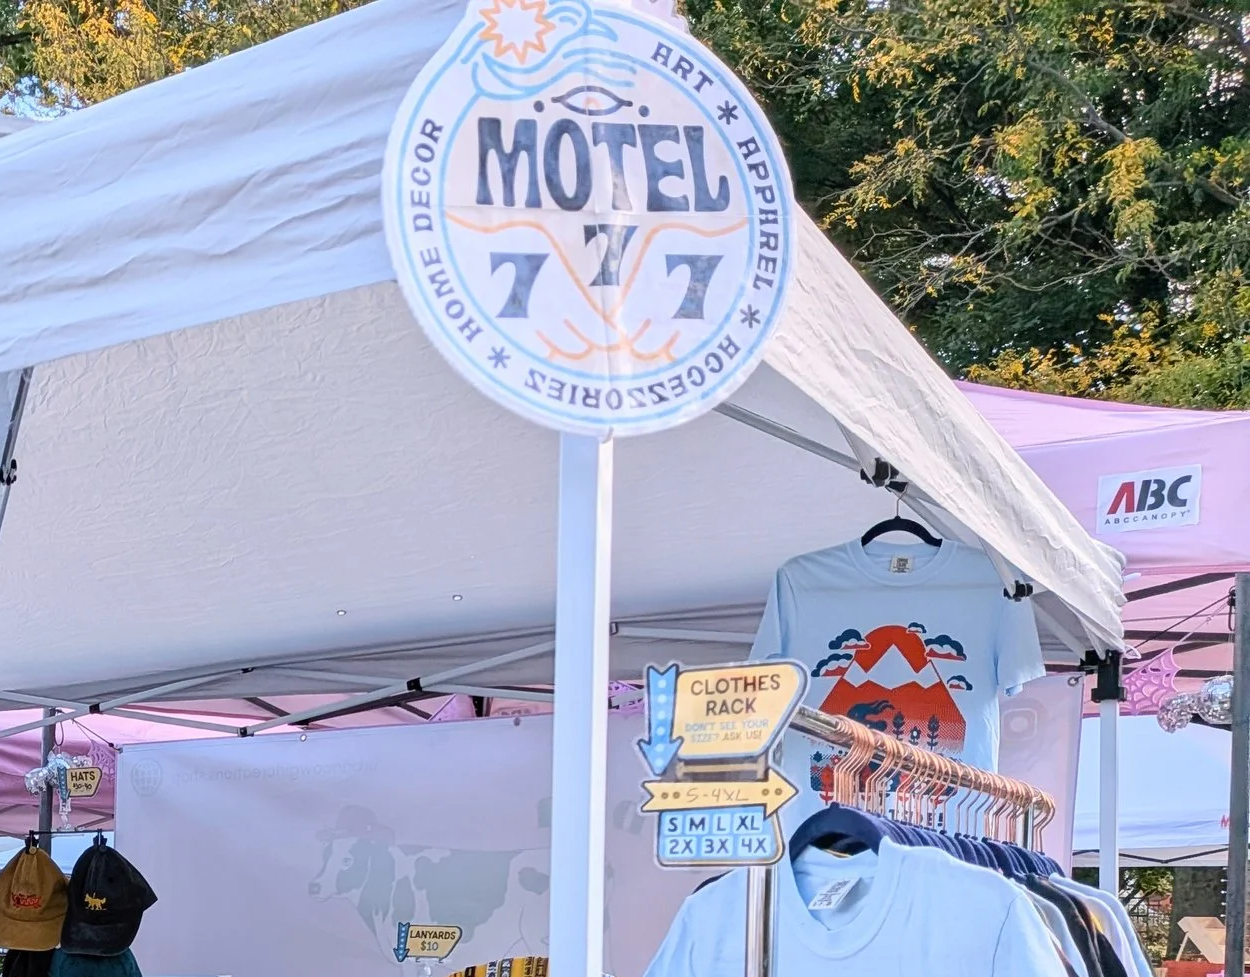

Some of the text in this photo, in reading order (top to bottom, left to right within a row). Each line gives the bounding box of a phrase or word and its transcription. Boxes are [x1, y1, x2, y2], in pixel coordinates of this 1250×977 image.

[651, 42, 714, 94] ART
[476, 117, 730, 212] MOTEL
[738, 137, 779, 290] APPAREL
[411, 118, 484, 342] HOME DECOR
[525, 335, 741, 410] ACCEZZORIEZ
[1107, 475, 1192, 515] ABC
[690, 674, 781, 696] CLOTHES
[705, 698, 756, 716] RACK
[685, 719, 769, 732] DON'T SEE YOUR
[691, 731, 762, 743] SIZE? ASK US!
[70, 771, 95, 781] HATS
[687, 788, 750, 803] S-4XL
[668, 815, 760, 832] S M L XL
[669, 837, 767, 854] 2X 3X 4X
[410, 930, 456, 940] LANYARDS
[420, 941, 439, 951] $10
